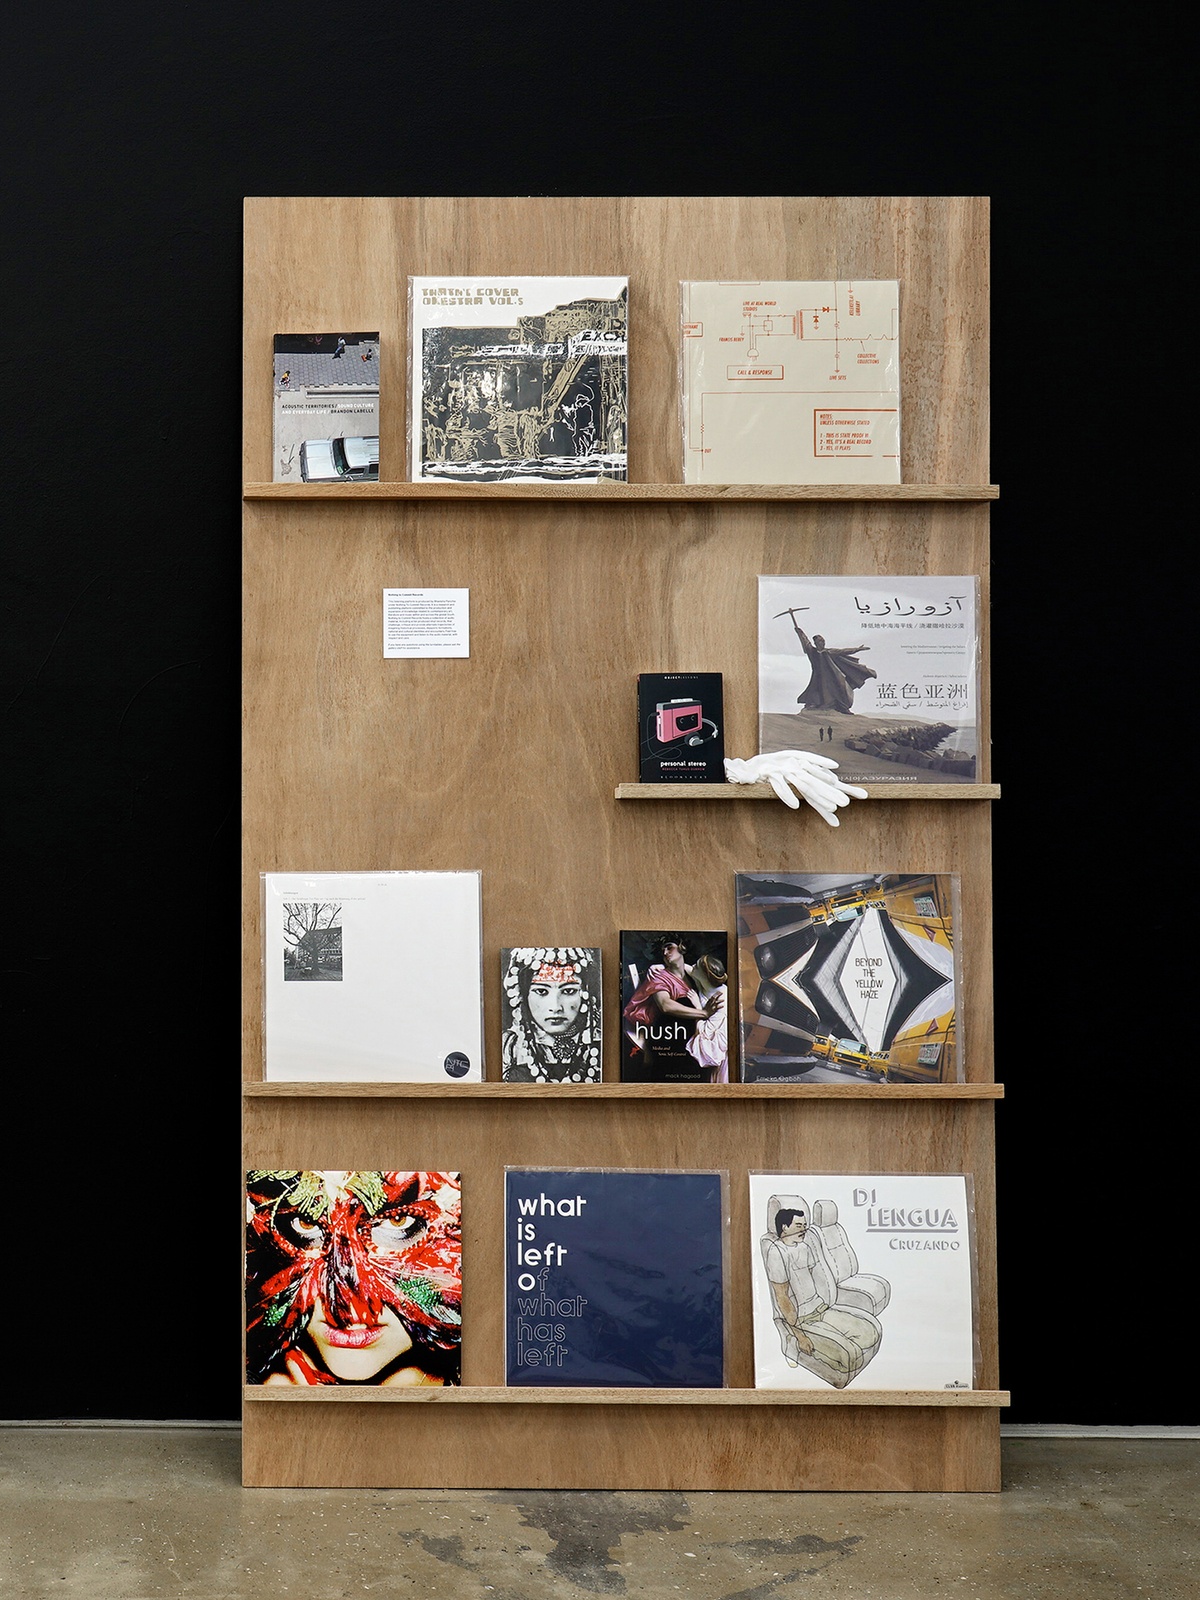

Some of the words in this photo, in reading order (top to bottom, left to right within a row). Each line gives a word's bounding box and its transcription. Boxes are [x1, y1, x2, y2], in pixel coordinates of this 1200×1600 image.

[476, 288, 519, 296] COVER
[876, 683, 968, 699] 蓝色亚洲
[855, 958, 883, 967] BEYOND
[863, 969, 875, 977] THE
[855, 979, 883, 988] YELLOW
[860, 990, 879, 999] HAZE
[635, 1021, 687, 1040] hush
[517, 1192, 587, 1216] what
[867, 1208, 958, 1228] LENGUA
[517, 1217, 536, 1241] is
[517, 1242, 567, 1266] left
[517, 1267, 550, 1291] of
[517, 1292, 588, 1317] what
[517, 1317, 566, 1342] has
[517, 1342, 568, 1367] left
